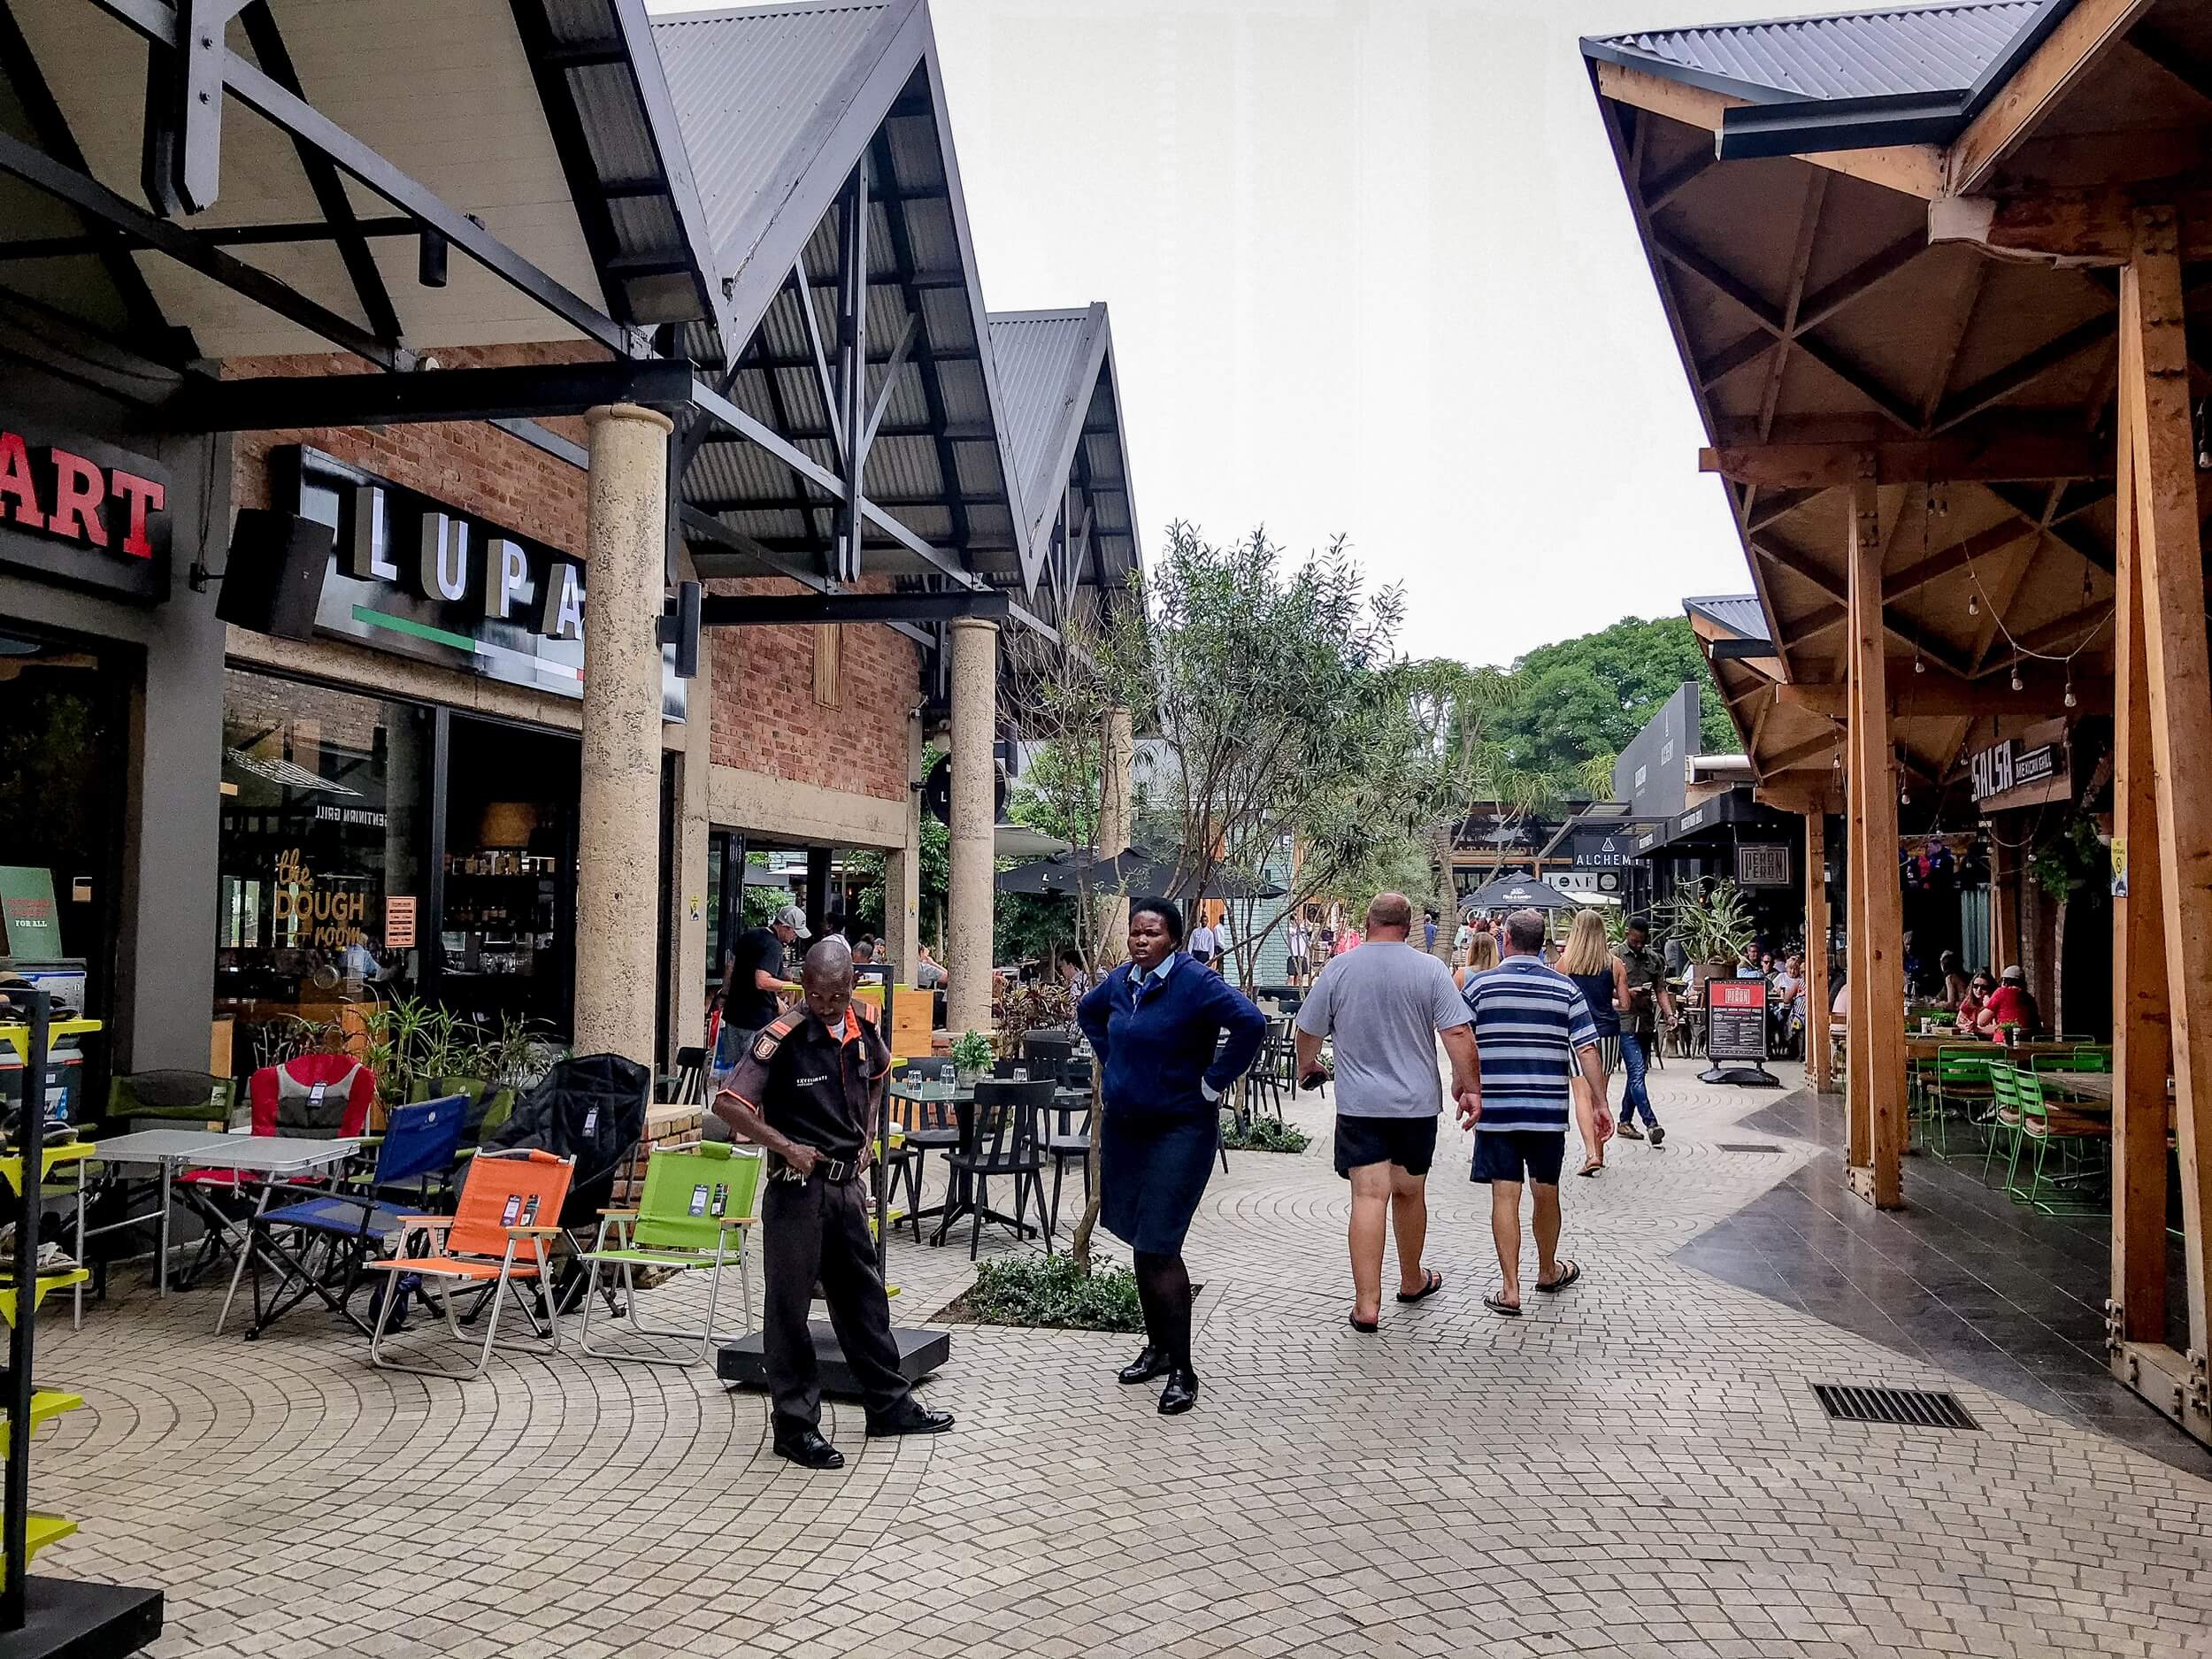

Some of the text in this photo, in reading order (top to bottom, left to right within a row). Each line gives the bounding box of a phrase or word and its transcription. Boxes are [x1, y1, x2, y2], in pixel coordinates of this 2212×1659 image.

[0, 431, 165, 559] ART
[355, 486, 587, 641] LUPA
[1971, 740, 2013, 800] SALSA
[276, 848, 314, 886] the
[276, 891, 365, 921] DOUGH
